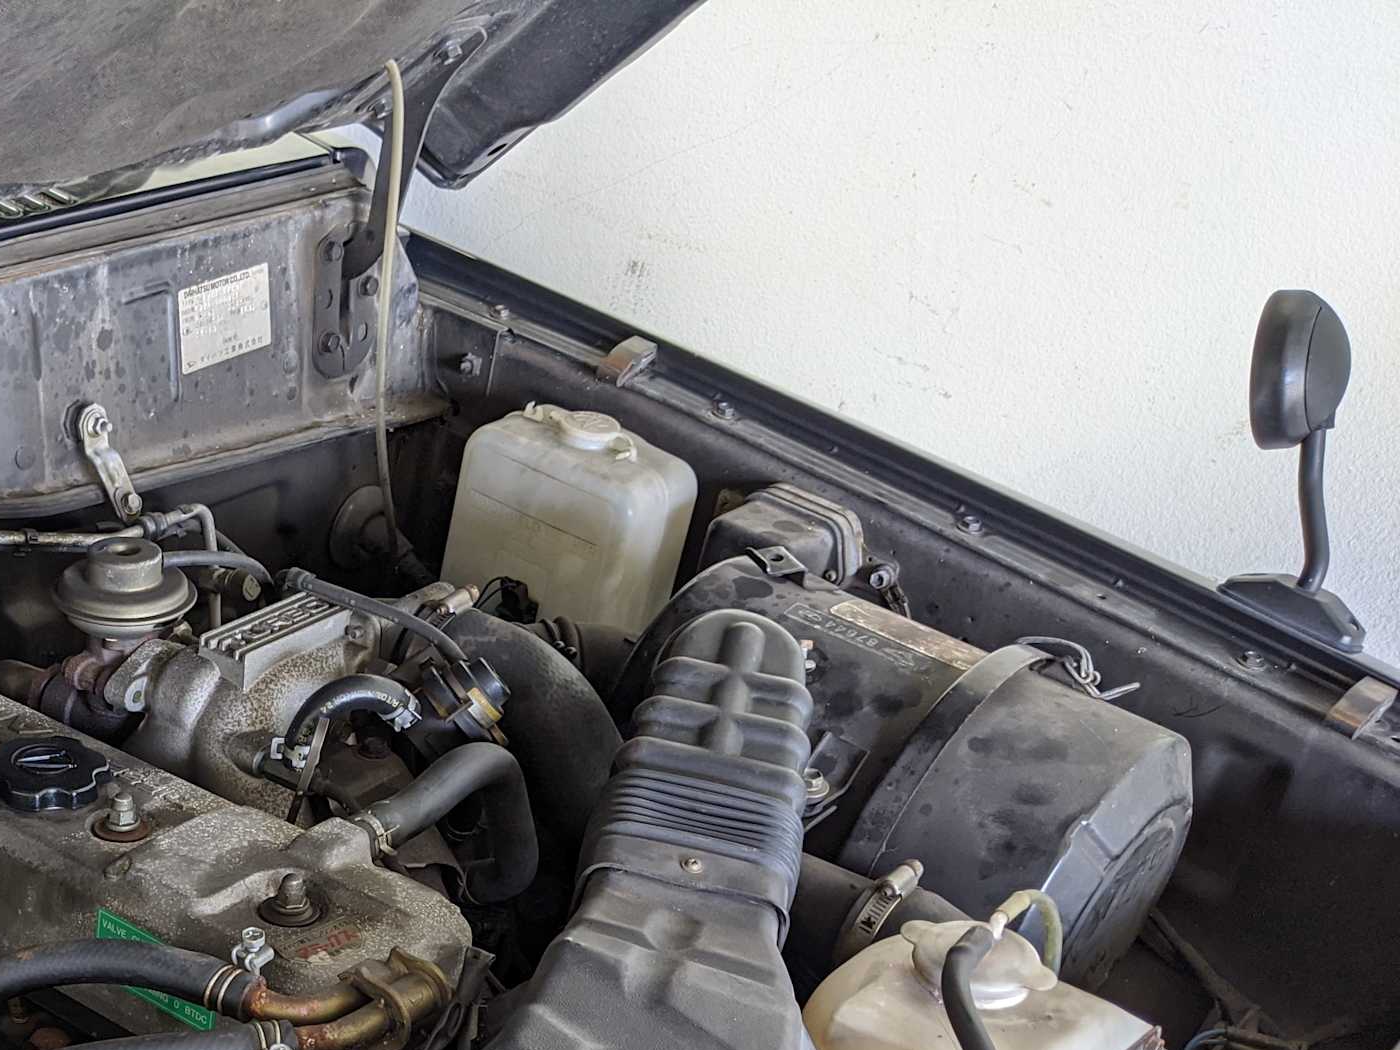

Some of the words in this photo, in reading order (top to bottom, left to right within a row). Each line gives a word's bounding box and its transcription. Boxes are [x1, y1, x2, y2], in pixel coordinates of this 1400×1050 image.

[183, 283, 210, 299] DAIHATSU
[210, 278, 229, 290] MOTOR
[101, 919, 127, 938] VALVE
[184, 1007, 208, 1025] BTDC
